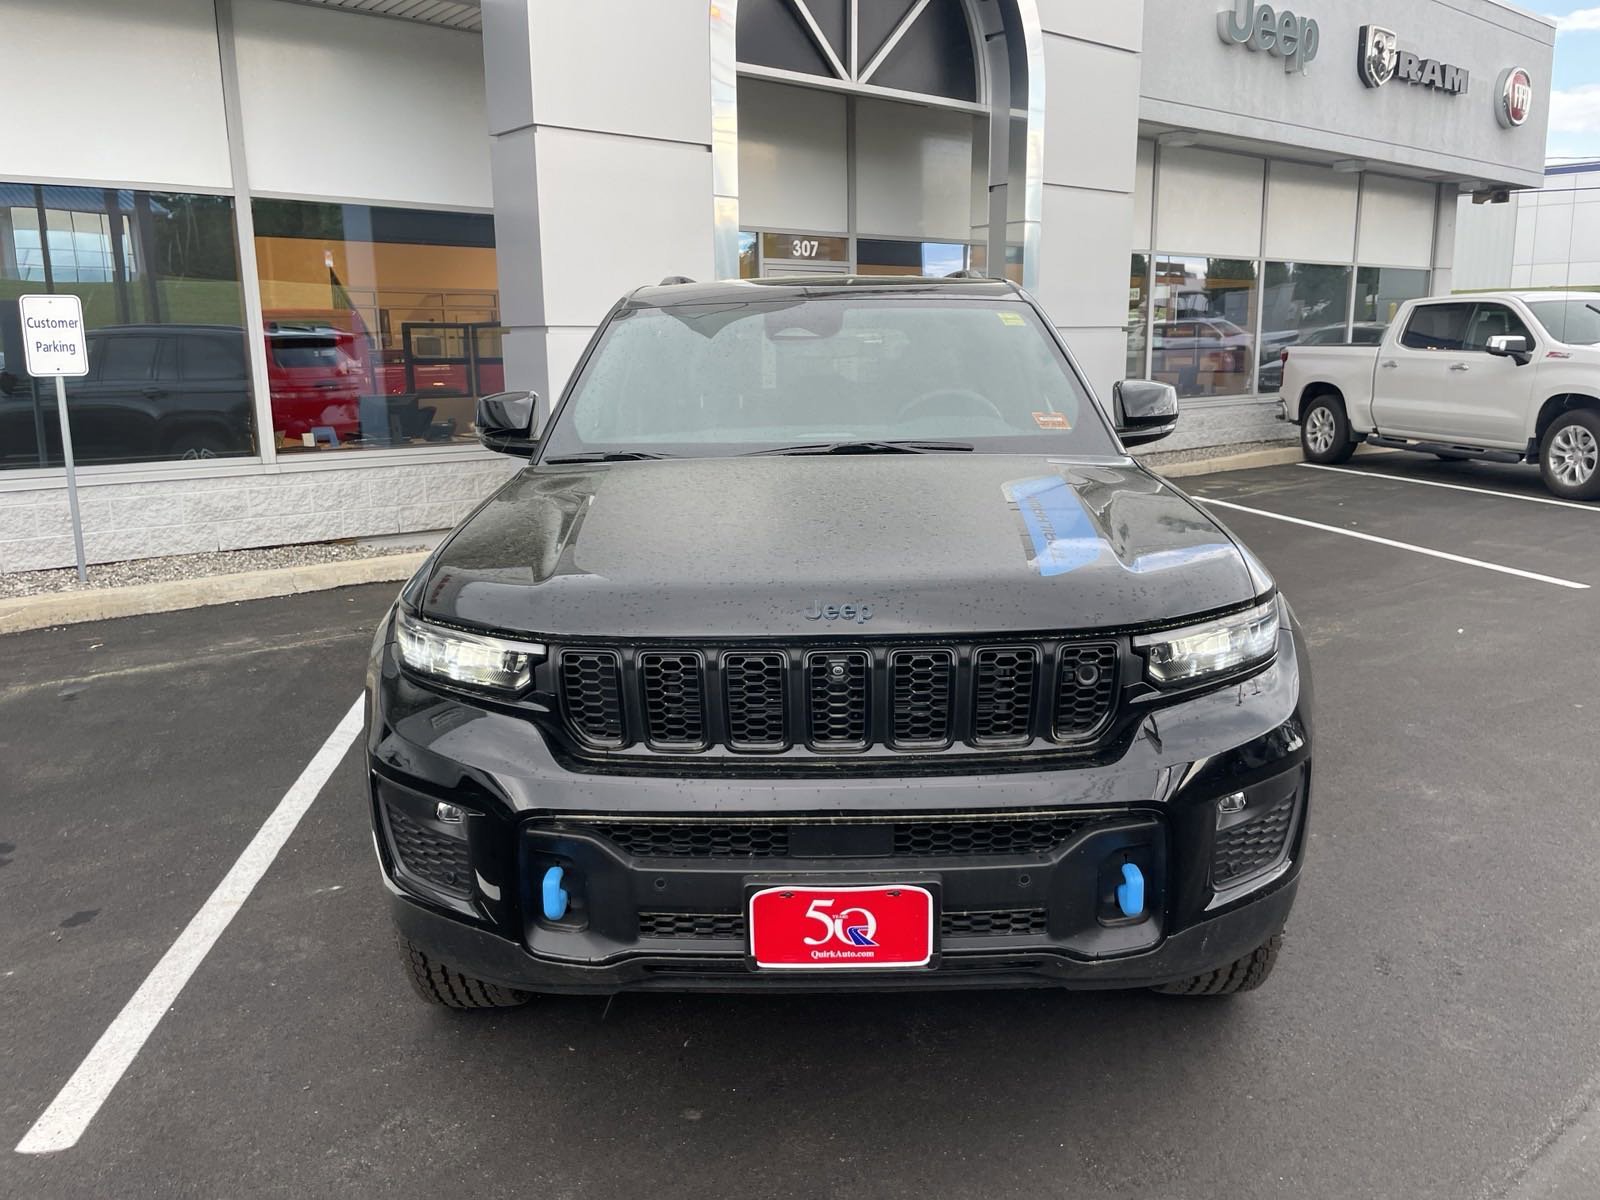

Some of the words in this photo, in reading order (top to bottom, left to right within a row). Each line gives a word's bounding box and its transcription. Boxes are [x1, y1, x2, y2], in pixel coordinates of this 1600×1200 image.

[1217, 0, 1319, 73] Jeep
[1397, 50, 1469, 94] RAM
[792, 239, 819, 257] 307
[26, 317, 79, 329] Customer
[35, 339, 76, 355] Parking
[802, 600, 874, 624] Jeep
[810, 950, 875, 960] QuirkAuto.com
